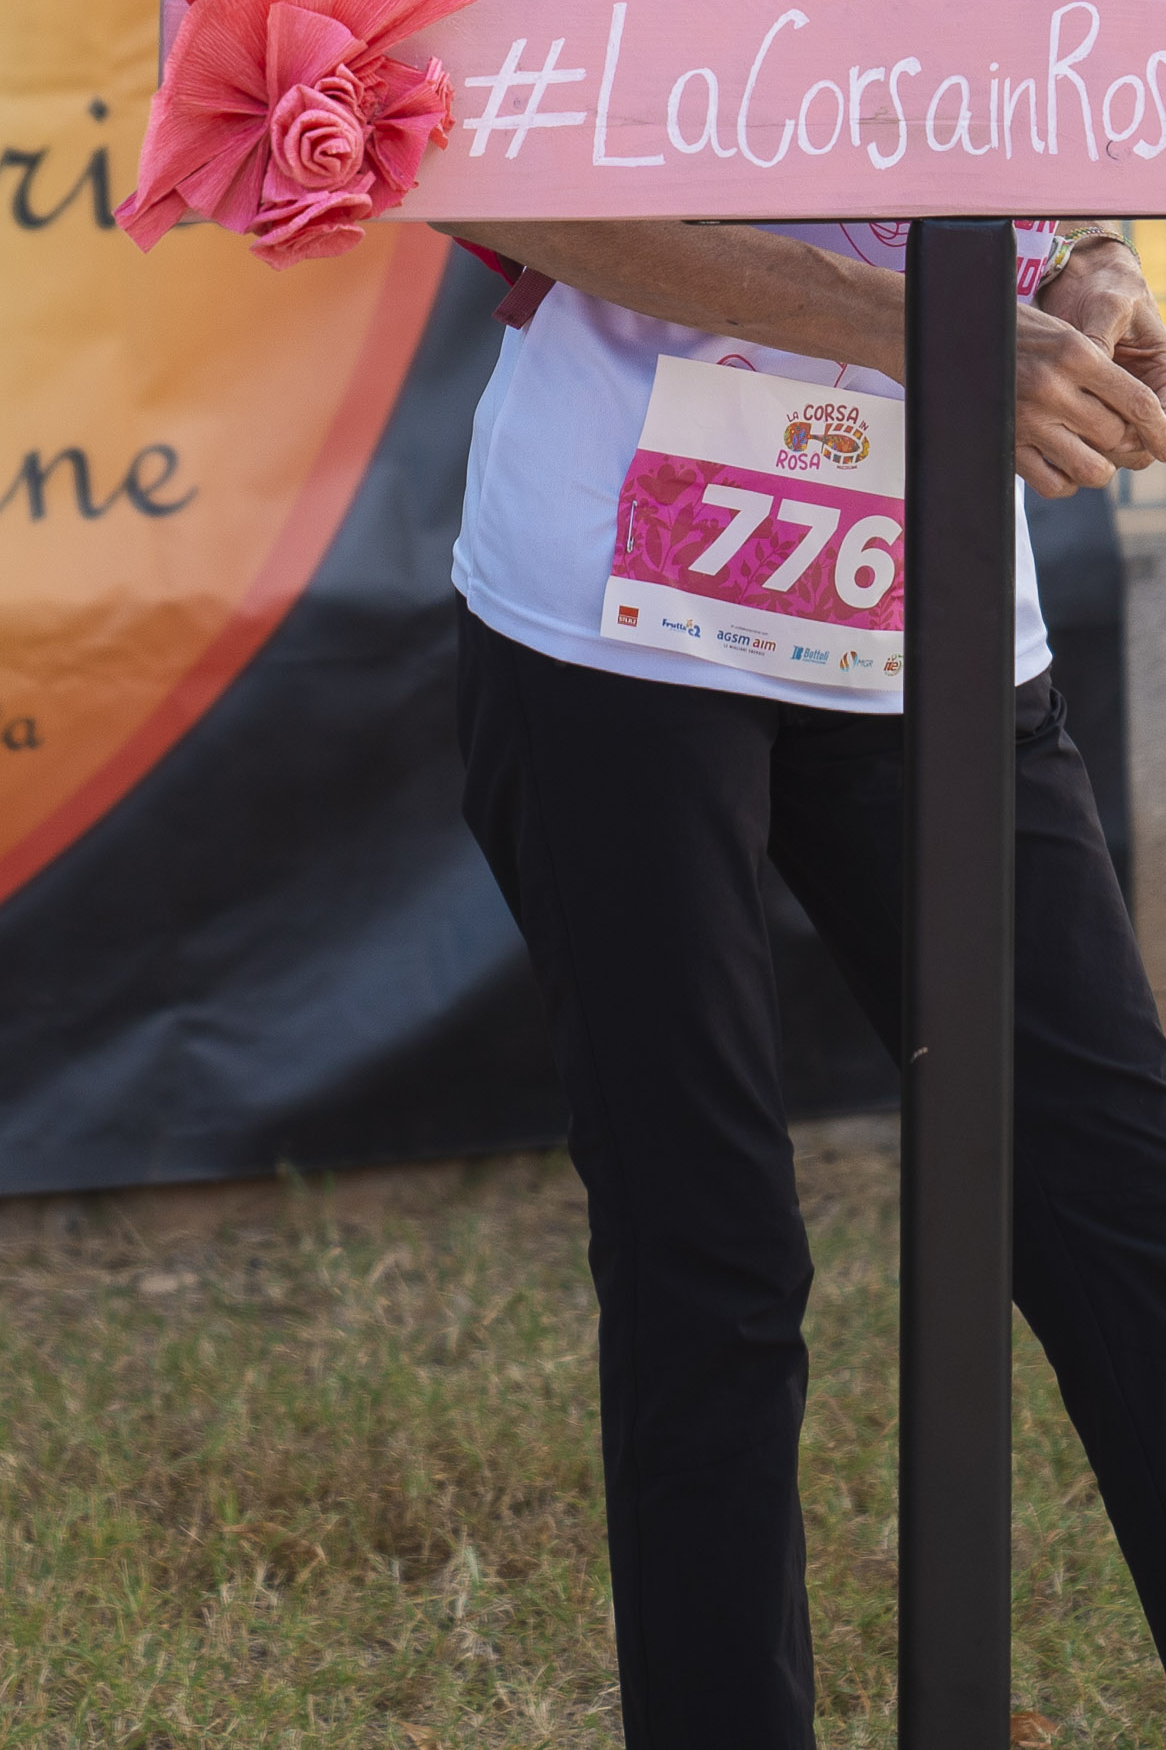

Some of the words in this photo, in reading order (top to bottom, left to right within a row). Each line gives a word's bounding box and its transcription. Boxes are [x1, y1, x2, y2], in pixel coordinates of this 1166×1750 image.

[786, 411, 799, 422] LA
[803, 403, 859, 424] CORSA
[859, 420, 869, 431] IN
[775, 449, 821, 471] ROSA
[688, 483, 903, 609] 776
